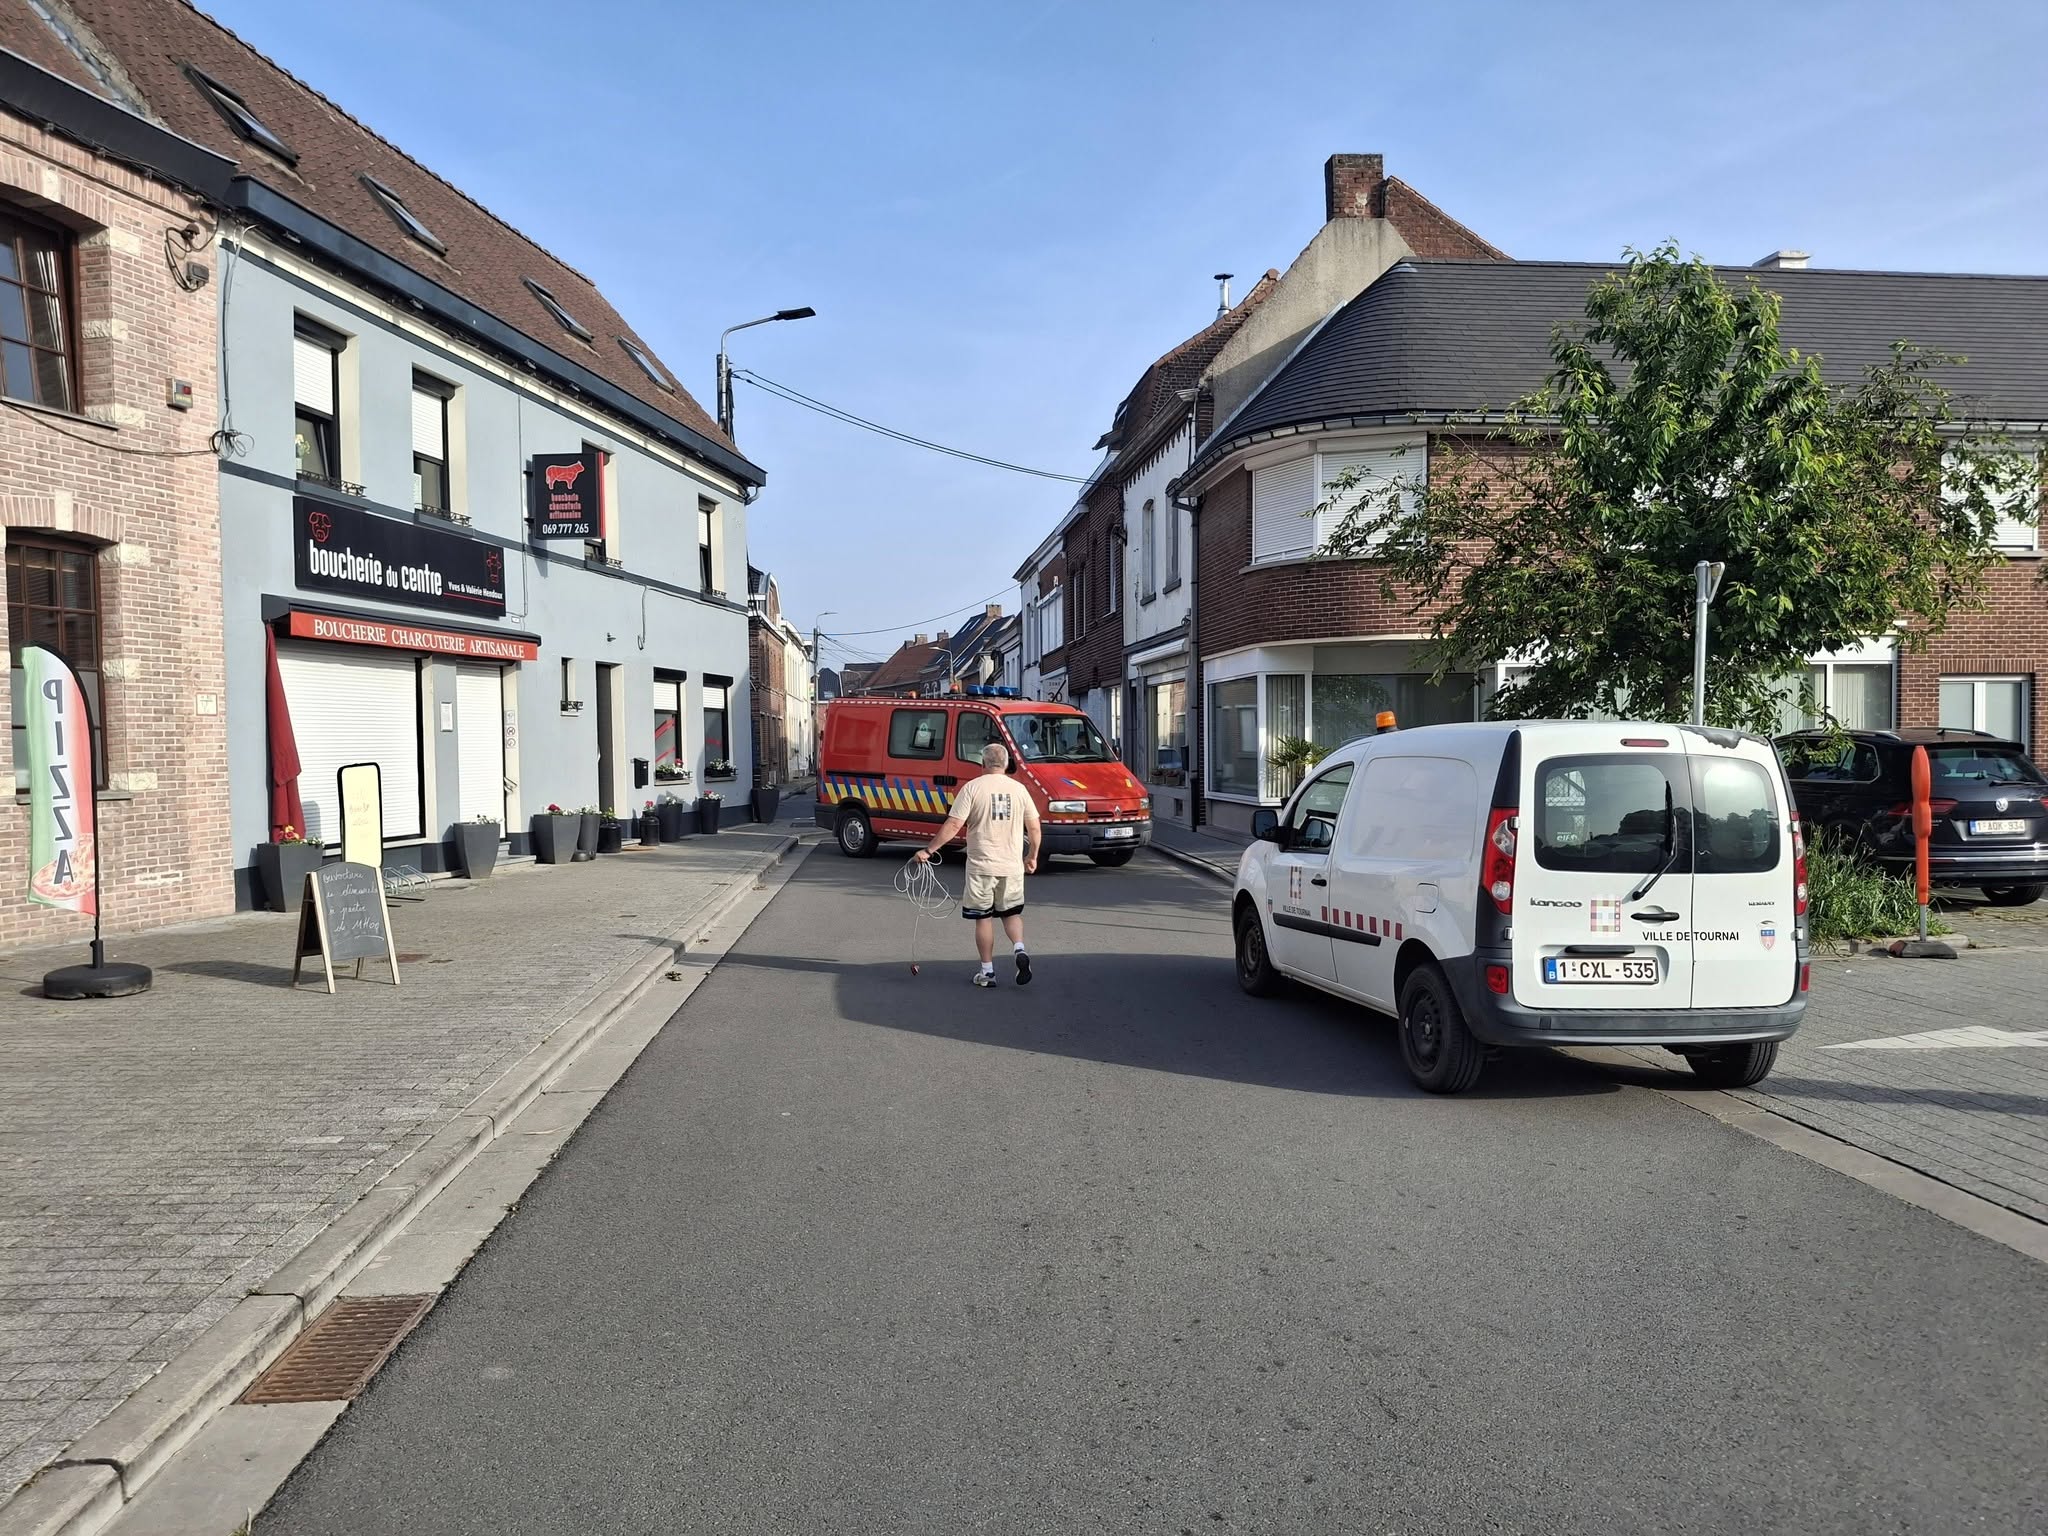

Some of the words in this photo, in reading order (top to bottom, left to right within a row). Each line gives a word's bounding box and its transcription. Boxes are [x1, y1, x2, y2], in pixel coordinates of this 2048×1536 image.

[542, 524, 573, 534] 069.777
[574, 523, 589, 533] 265
[309, 539, 382, 585] boucherie
[386, 565, 398, 588] du
[401, 564, 442, 596] centre
[447, 581, 460, 592] Yves
[314, 619, 387, 643] BOUCHERIE
[391, 629, 466, 652] CHARCUTERIE
[469, 639, 525, 658] ARTISANALE
[1642, 931, 1673, 941] VILLE
[1676, 931, 1691, 941] DE
[1693, 931, 1739, 941] TOURNAI
